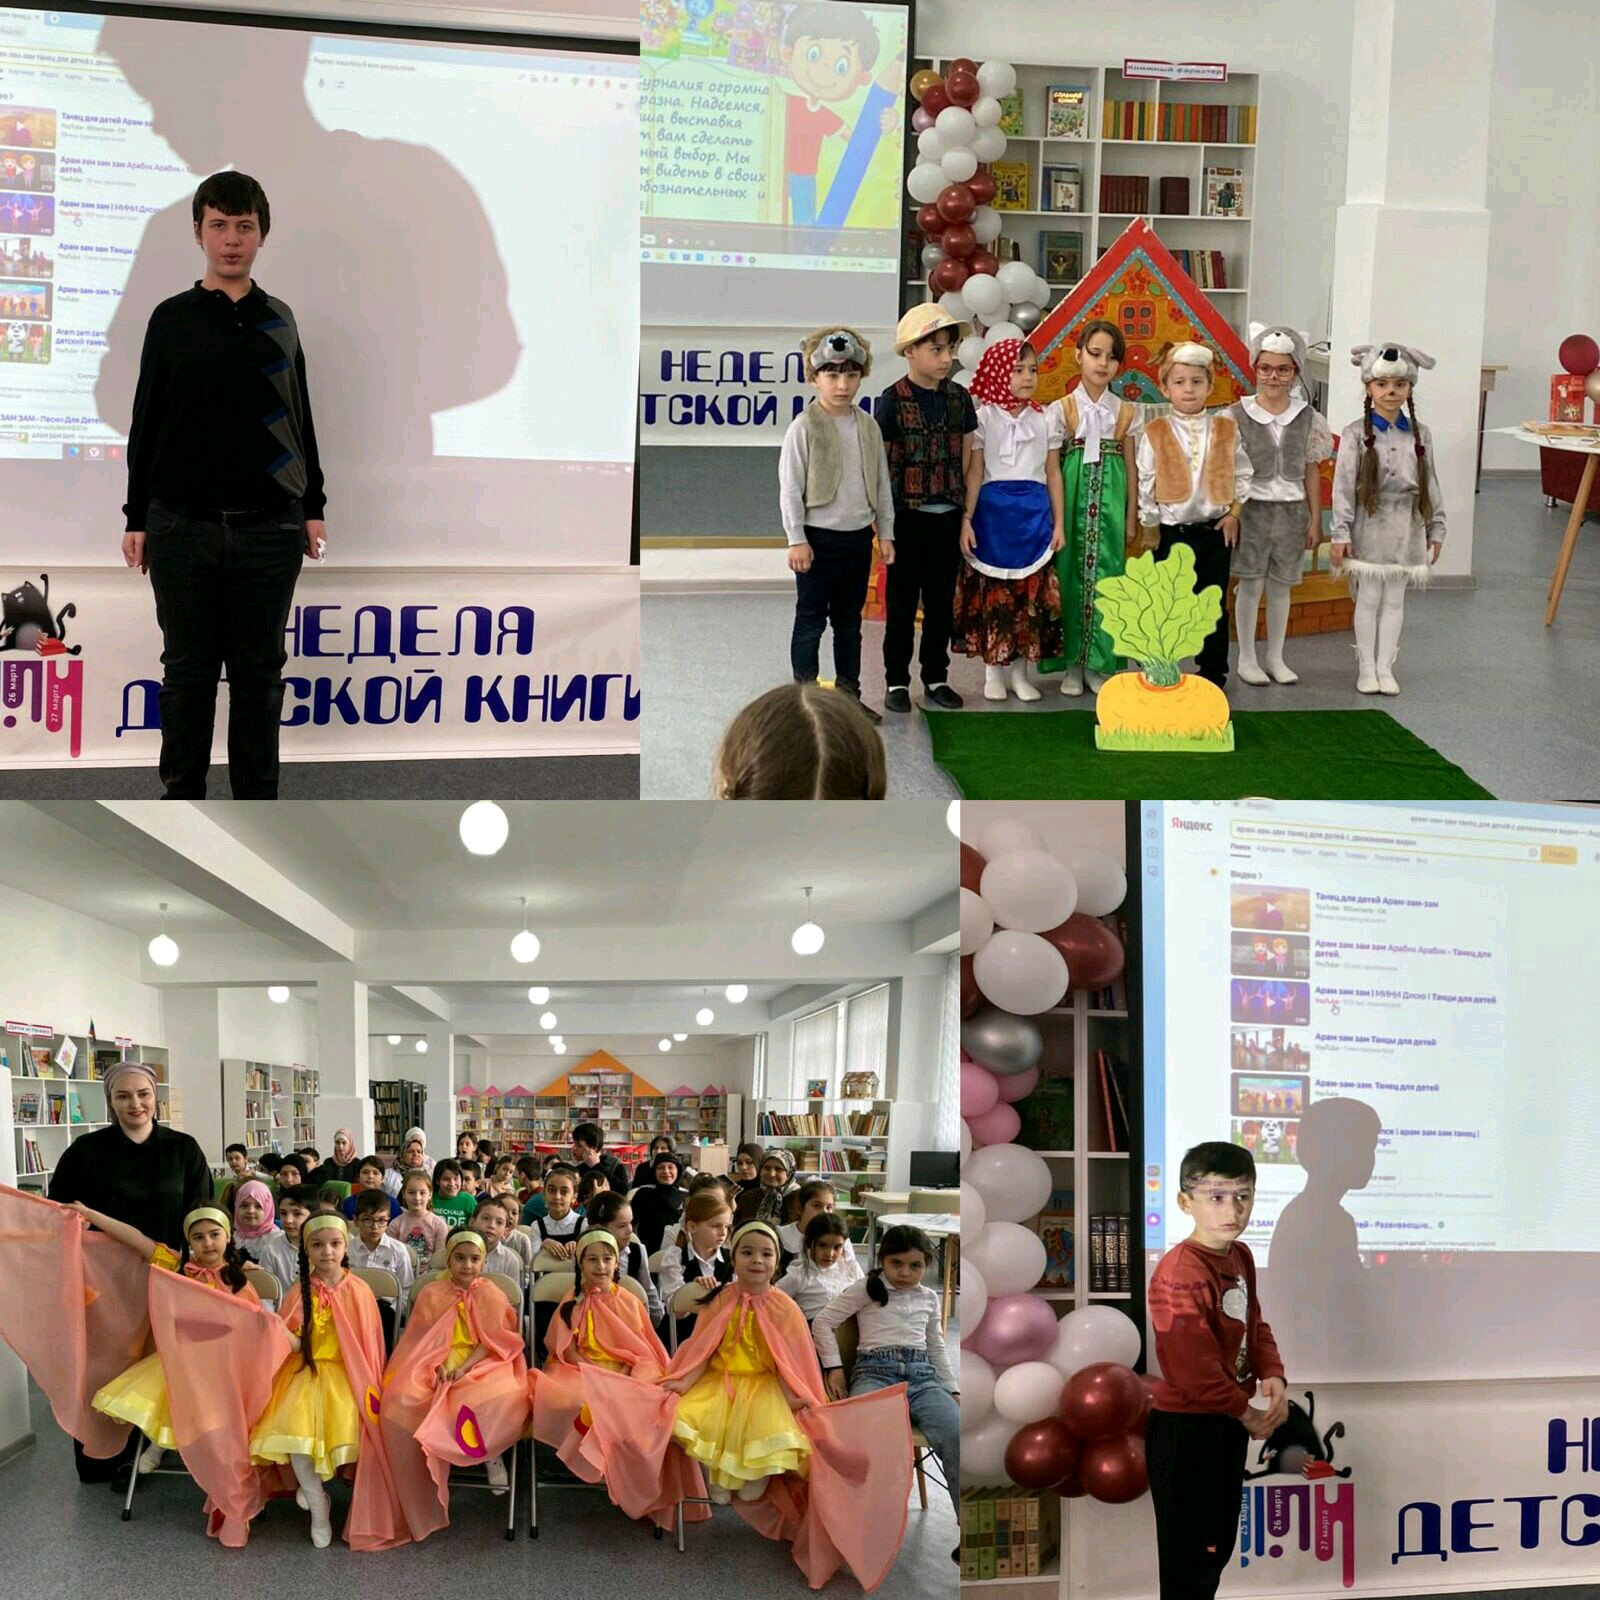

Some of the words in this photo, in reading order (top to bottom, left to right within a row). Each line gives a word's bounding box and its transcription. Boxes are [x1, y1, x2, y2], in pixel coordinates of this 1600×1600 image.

[709, 81, 770, 97] огромна
[691, 96, 764, 114] Надеемся,
[62, 112, 85, 121] Танец
[100, 116, 121, 124] детей
[670, 111, 742, 129] выставка
[657, 127, 686, 142] вам
[691, 130, 753, 146] сделать
[60, 155, 81, 165] Арам
[112, 160, 126, 168] зам
[674, 146, 720, 166] выбор.
[725, 151, 750, 164] Мы
[59, 166, 84, 174] детей.
[655, 163, 709, 178] видеть
[714, 166, 723, 180] в
[727, 168, 767, 183] своих
[757, 190, 765, 199] и
[59, 200, 80, 209] Арам
[58, 243, 79, 251] Арам
[110, 246, 132, 255] Танцы
[56, 328, 75, 336] Aram
[55, 338, 84, 346] детский
[660, 350, 806, 387] НЕДЕЛ
[640, 391, 778, 426] ТСКОЙ
[64, 416, 80, 424] Для
[10, 663, 18, 691] марта
[8, 691, 17, 703] 26
[53, 684, 61, 710] марта
[116, 669, 441, 738] ДСКОЙ
[51, 711, 59, 723] 27
[1171, 817, 1213, 832] Яндекс
[1230, 870, 1257, 880] Видео
[1315, 892, 1341, 902] Танец
[1341, 895, 1356, 903] для
[1357, 896, 1381, 904] детей
[1315, 939, 1337, 949] Арам
[1388, 944, 1416, 953] Арабик
[1452, 948, 1476, 958] Танец
[1315, 950, 1341, 959] детей.
[1315, 986, 1337, 995] Арам
[1432, 993, 1457, 1002] Танцы
[1473, 996, 1497, 1004] детей
[1315, 1033, 1337, 1042] Арам
[1371, 1036, 1397, 1045] Танцы
[1413, 1038, 1437, 1046] детей
[1375, 1081, 1400, 1091] Танец
[1400, 1084, 1415, 1092] для
[1416, 1083, 1440, 1092] детей
[1400, 1129, 1421, 1138] арам
[1438, 1130, 1453, 1138] зам
[1454, 1131, 1476, 1139] танец
[1256, 1220, 1274, 1228] ЗАМ
[1547, 1417, 1600, 1475] Н
[1275, 1489, 1284, 1517] марта
[1273, 1519, 1282, 1531] 26
[1322, 1510, 1331, 1537] марта
[1391, 1494, 1600, 1566] ДЕТС
[1321, 1540, 1329, 1551] 27
